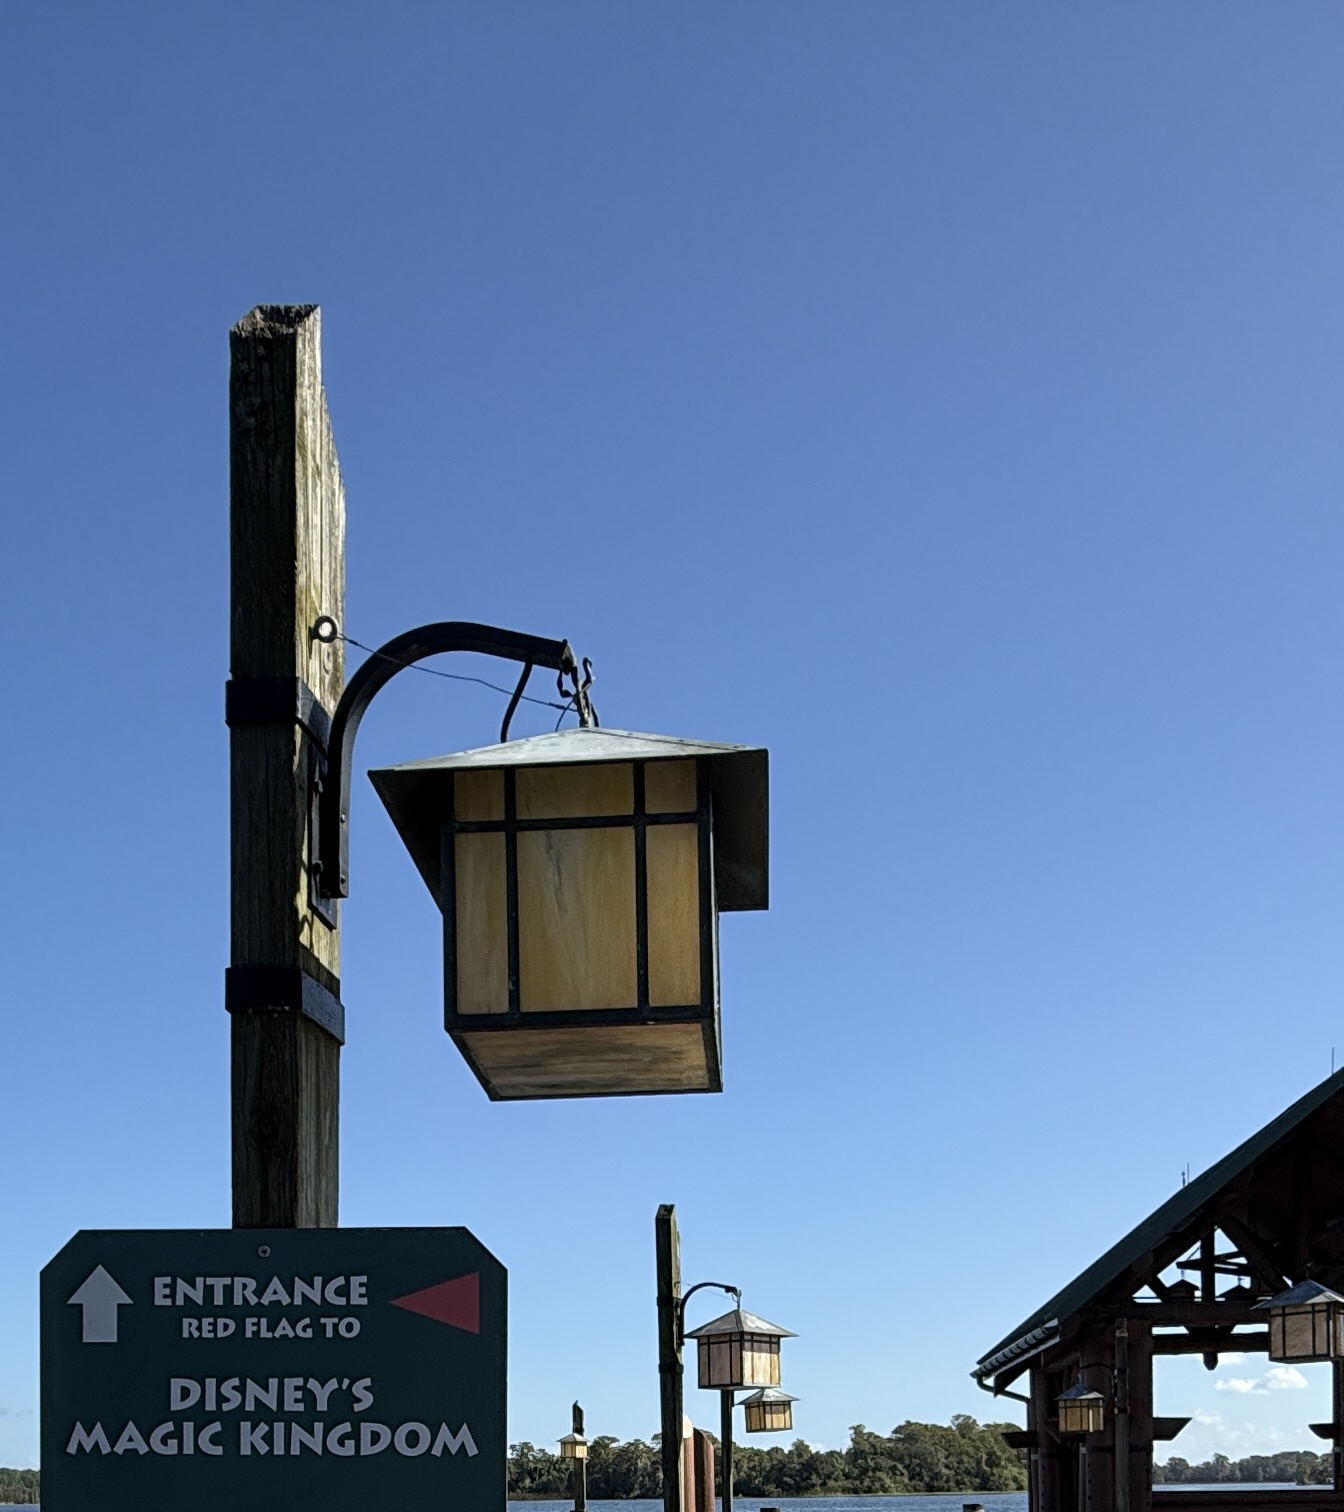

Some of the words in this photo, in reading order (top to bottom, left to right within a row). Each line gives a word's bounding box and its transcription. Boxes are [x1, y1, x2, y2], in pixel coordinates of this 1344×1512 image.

[153, 1275, 368, 1306] ENTRANCE
[182, 1317, 236, 1338] RED
[245, 1317, 313, 1338] FLAG
[320, 1317, 361, 1338] TO
[170, 1377, 374, 1412] DISNEY'S
[65, 1419, 224, 1457] MAGIC
[240, 1421, 479, 1457] KINGDOM
